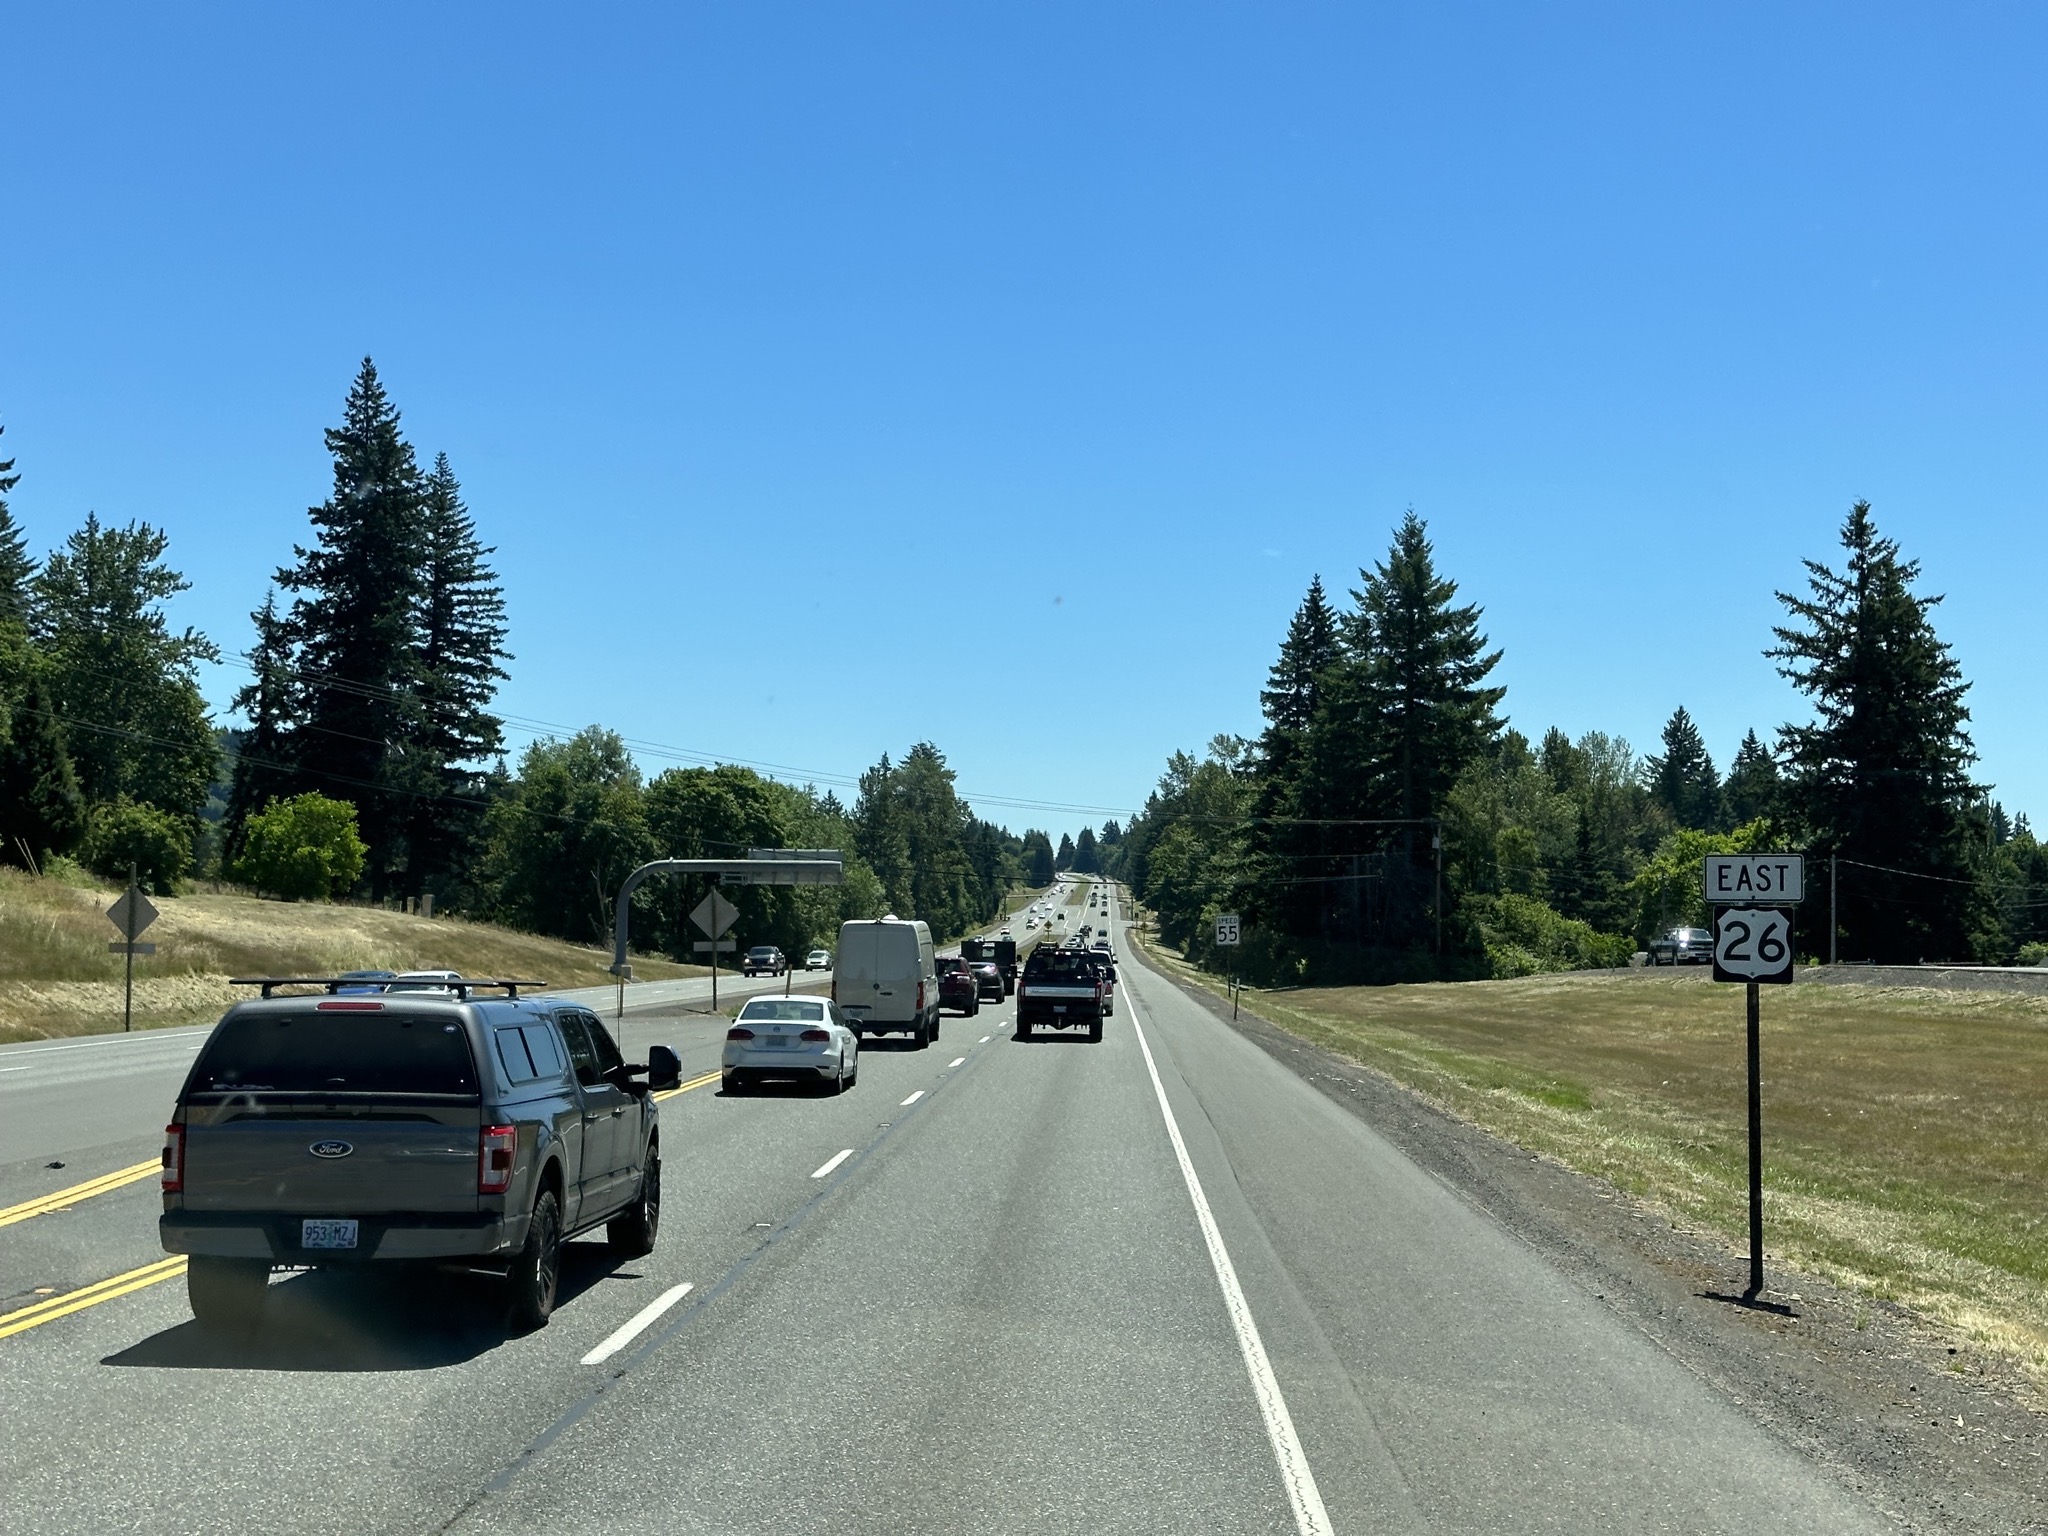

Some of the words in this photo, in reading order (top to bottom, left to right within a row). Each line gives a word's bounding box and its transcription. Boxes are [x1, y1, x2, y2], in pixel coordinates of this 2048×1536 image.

[1718, 865, 1789, 892] EAST
[1218, 926, 1238, 942] 55
[1723, 920, 1786, 963] 26
[319, 1143, 343, 1154] Ford
[305, 1226, 327, 1241] 953
